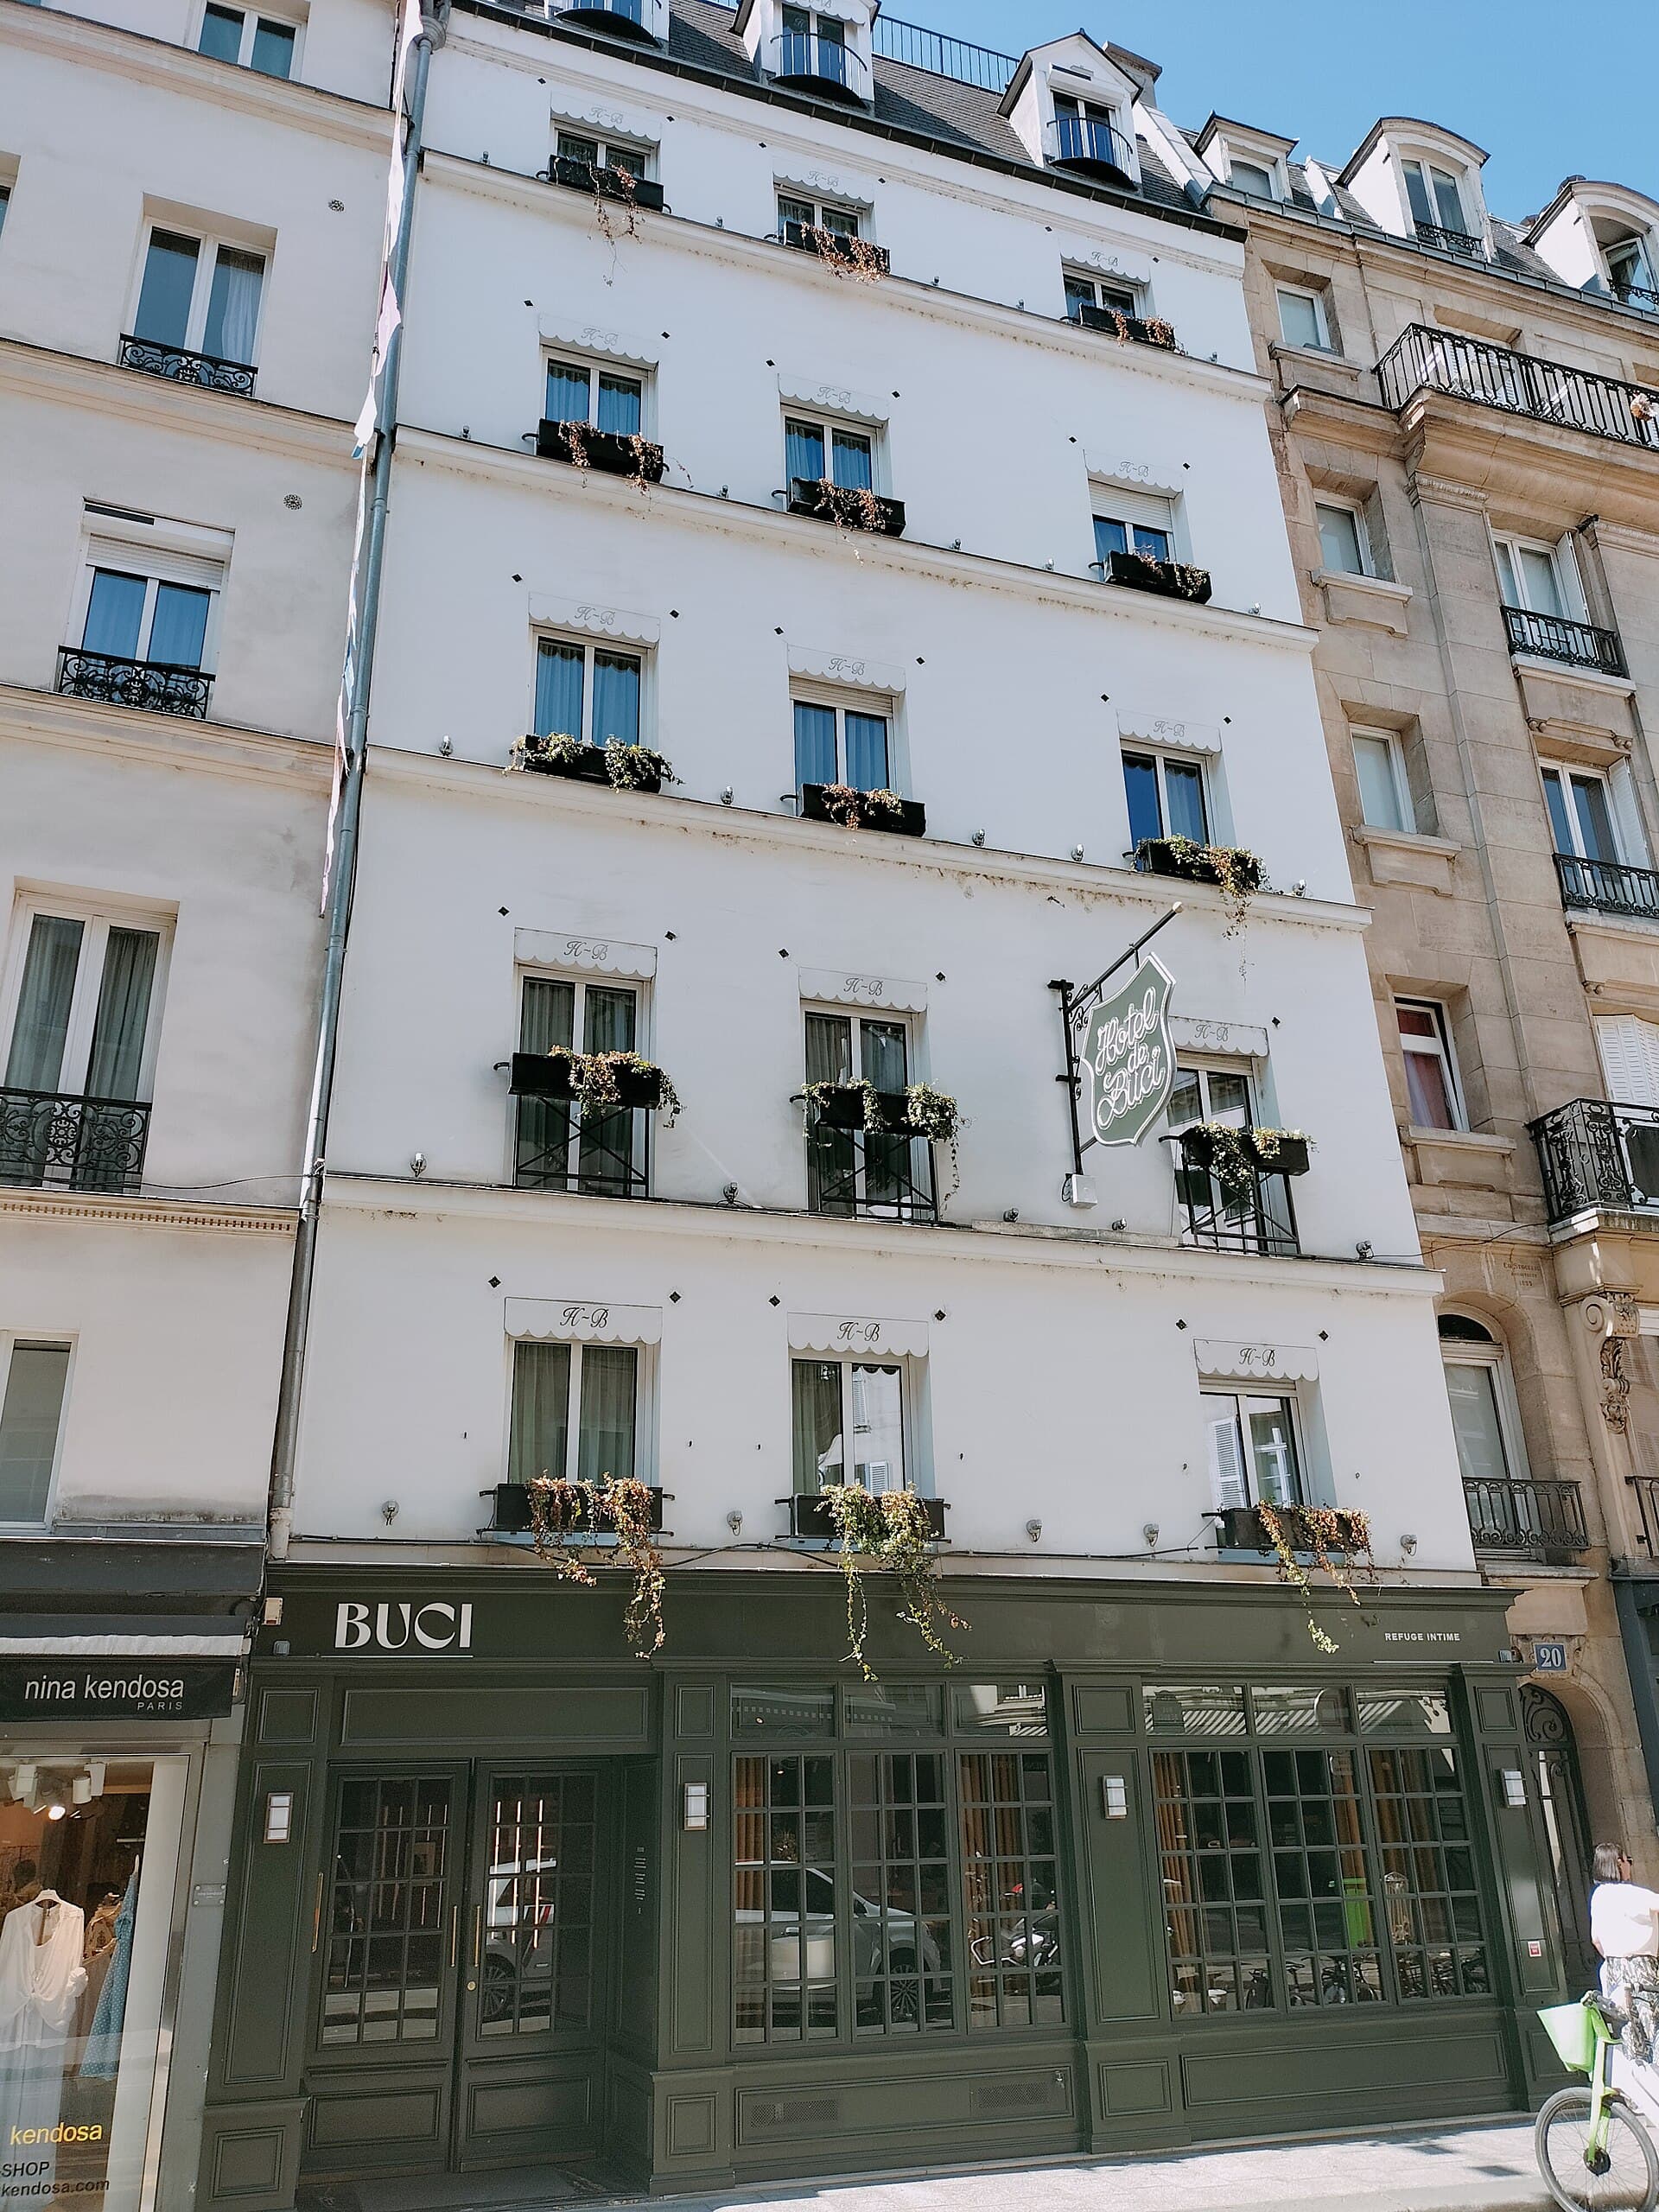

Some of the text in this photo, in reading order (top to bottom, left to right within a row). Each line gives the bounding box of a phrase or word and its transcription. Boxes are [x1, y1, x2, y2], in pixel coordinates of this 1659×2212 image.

[1095, 986, 1160, 1076] Hotel
[1127, 1042, 1149, 1072] de
[334, 1602, 473, 1649] BUCI
[1384, 1632, 1460, 1642] REFUGE INTIME
[1540, 1647, 1562, 1668] 20
[24, 1674, 184, 1700] nina kendosa
[137, 1701, 183, 1711] PARIS
[10, 2121, 103, 2145] kendosa
